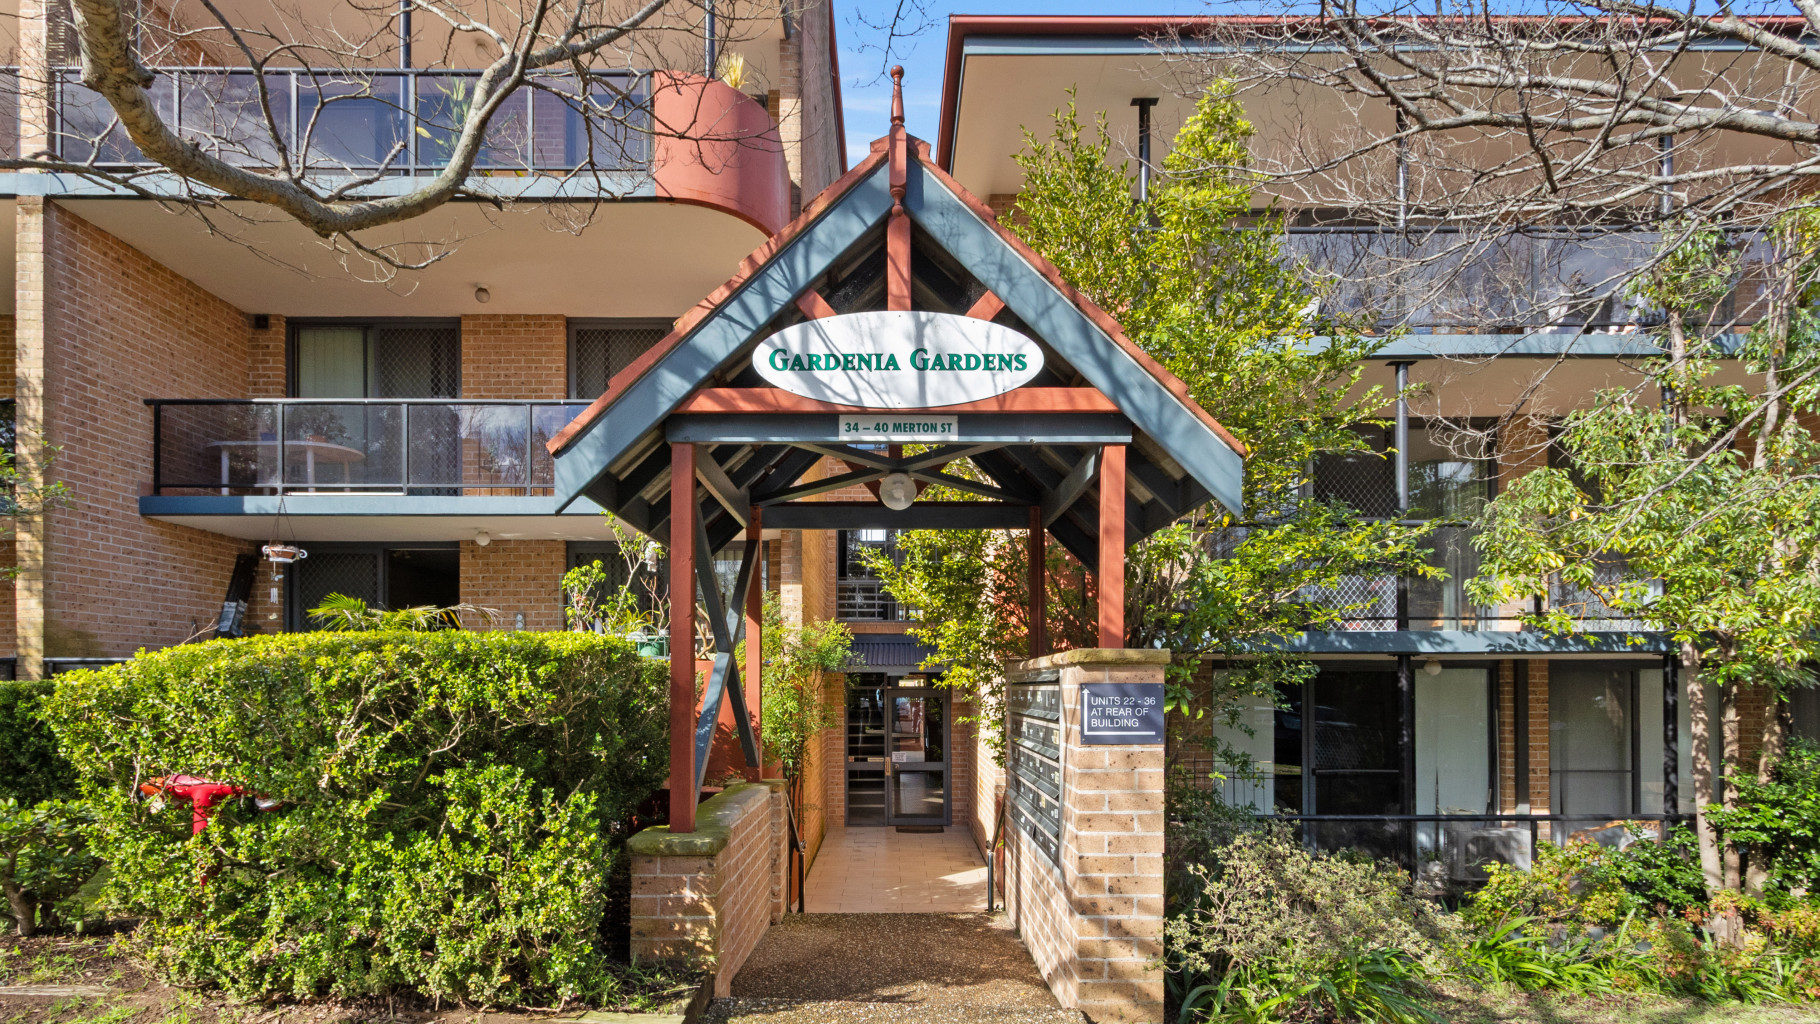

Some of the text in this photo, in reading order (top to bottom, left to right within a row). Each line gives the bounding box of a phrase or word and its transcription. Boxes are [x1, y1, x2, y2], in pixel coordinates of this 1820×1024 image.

[769, 348, 1027, 372] GARDENIA GARDENS
[844, 422, 860, 433] 34
[873, 422, 889, 433] 40
[892, 422, 938, 433] MERTON
[940, 422, 953, 433] ST
[1091, 697, 1121, 705] UNITS
[1123, 697, 1135, 705] 22
[1144, 697, 1156, 705] 36
[1091, 707, 1149, 716] AT REAR OF
[1091, 718, 1139, 728] BUILDING
